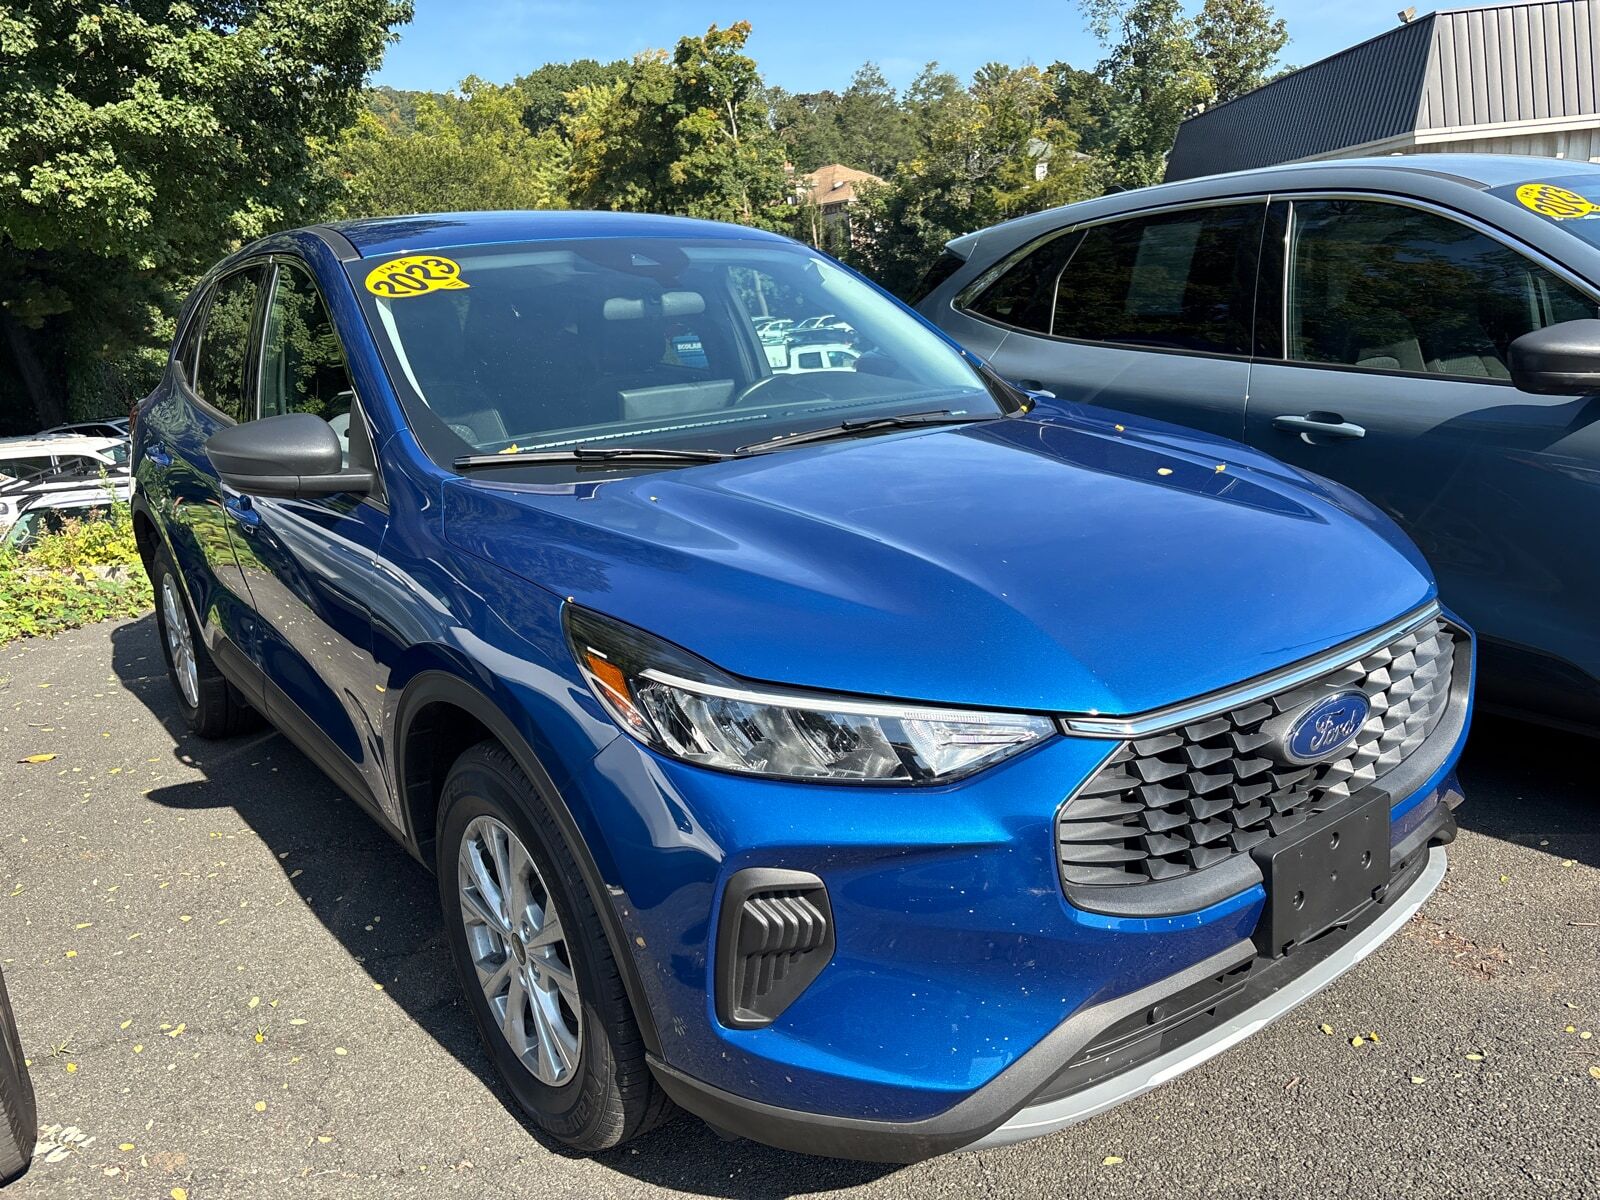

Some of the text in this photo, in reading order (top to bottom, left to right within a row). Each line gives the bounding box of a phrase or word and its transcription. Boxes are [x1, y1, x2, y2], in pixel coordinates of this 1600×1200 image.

[1534, 186, 1586, 215] 2023
[373, 259, 455, 295] 2023
[1309, 707, 1360, 752] Ford
